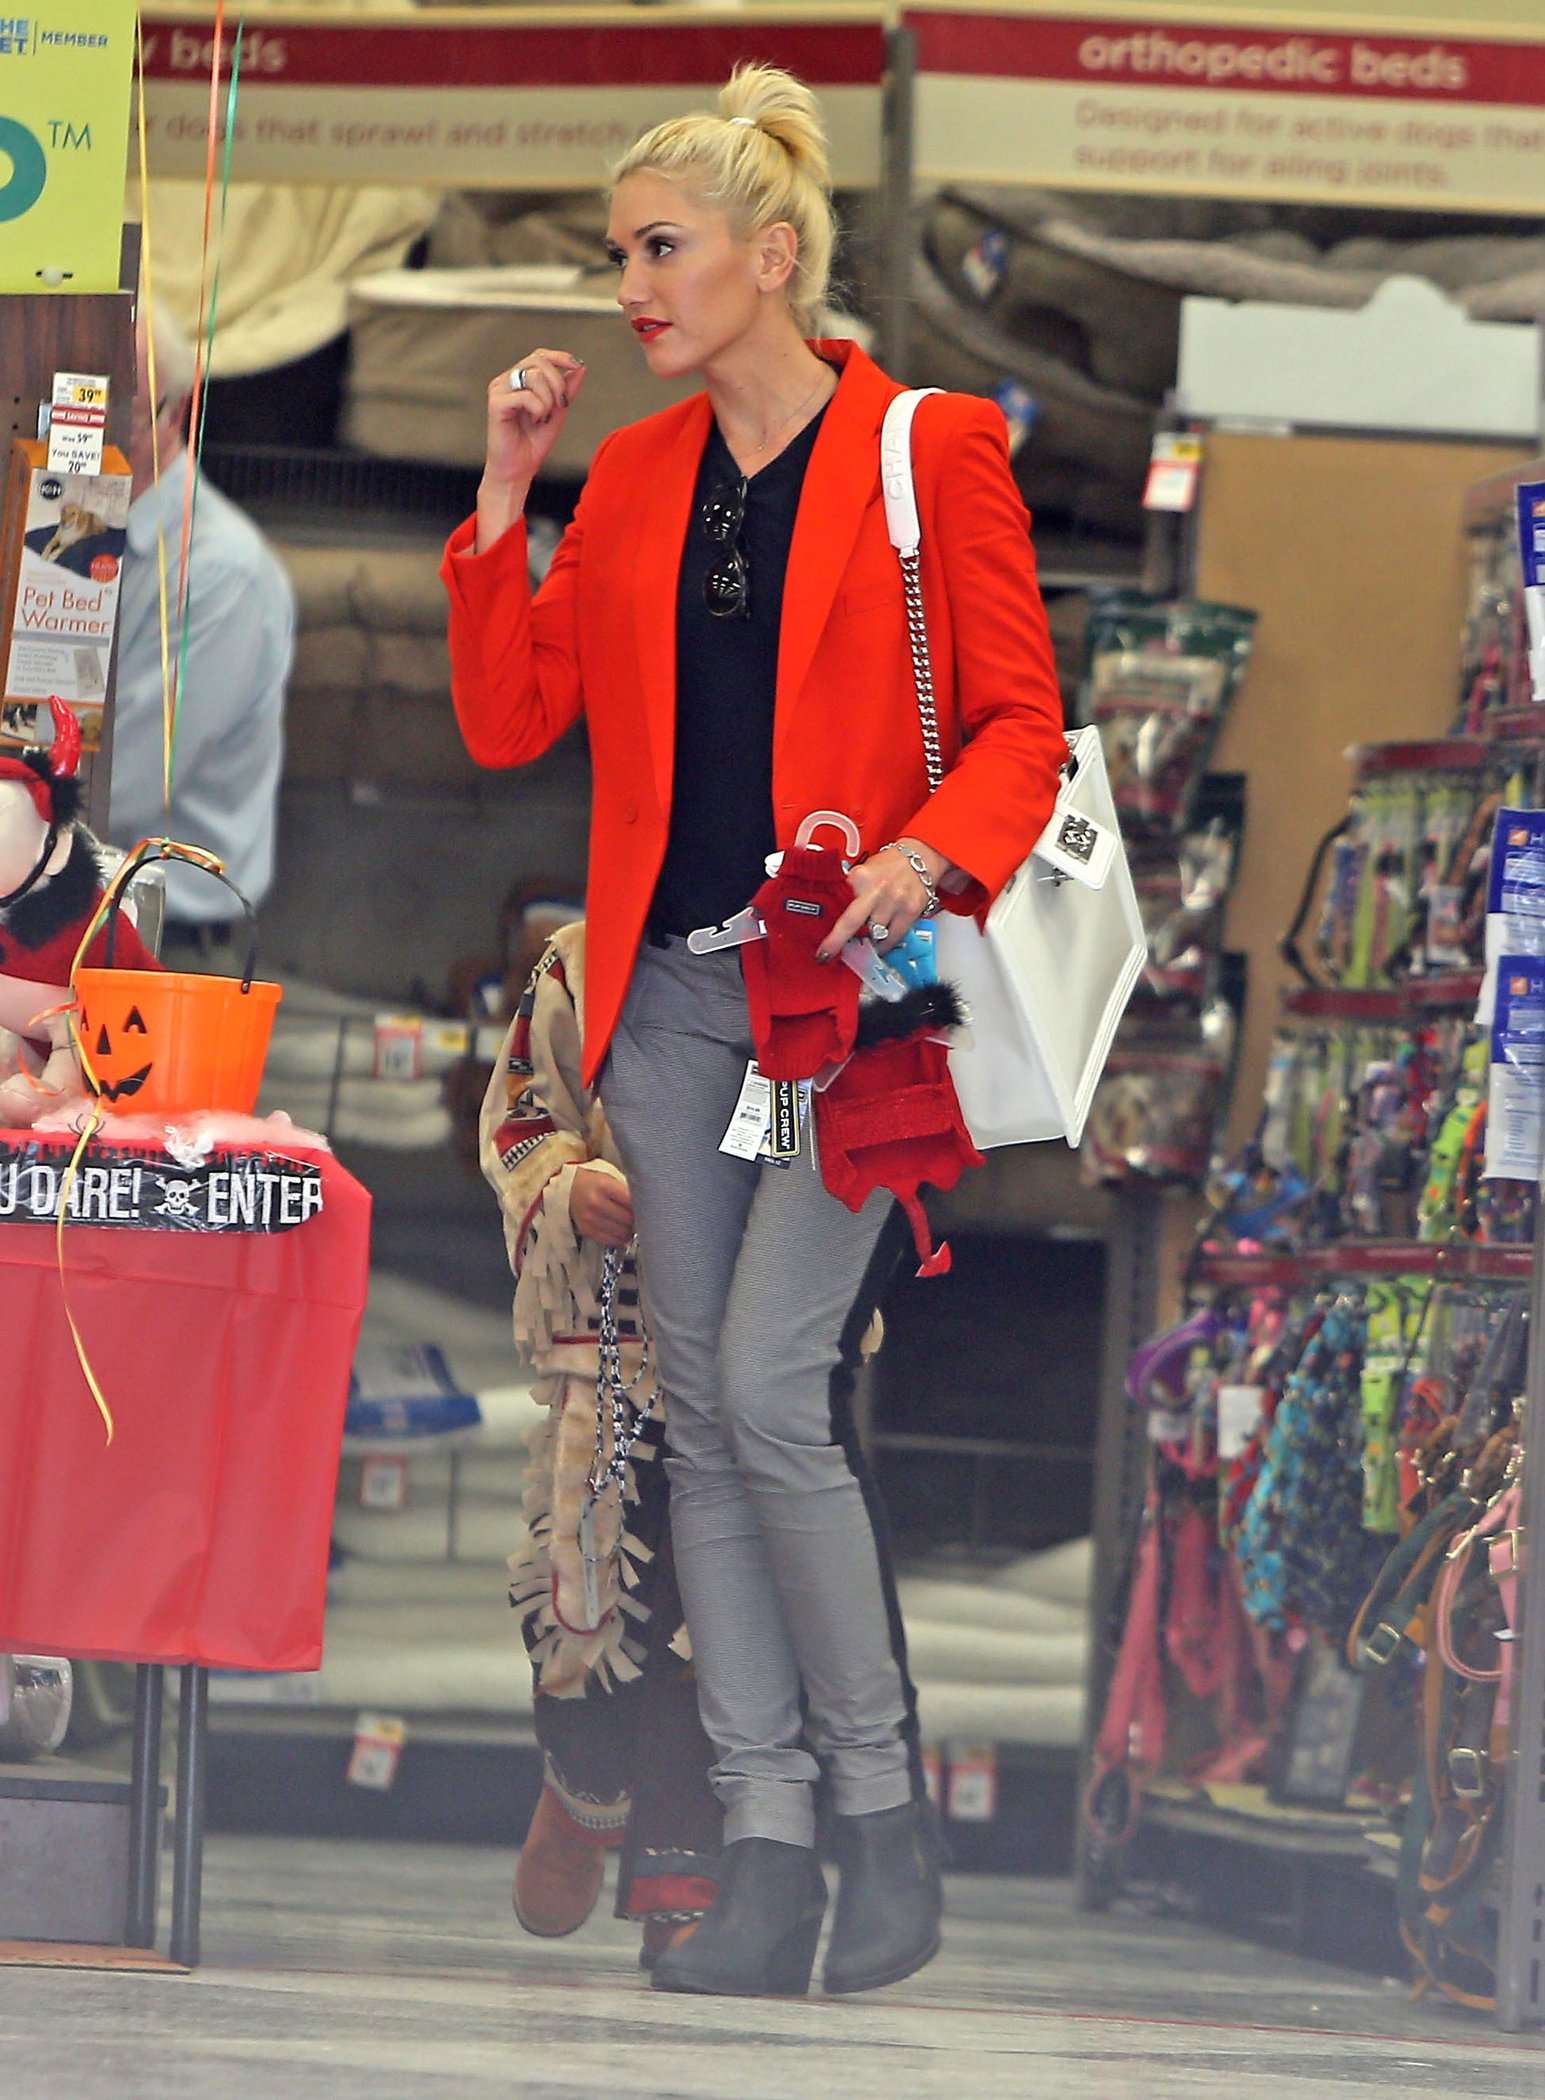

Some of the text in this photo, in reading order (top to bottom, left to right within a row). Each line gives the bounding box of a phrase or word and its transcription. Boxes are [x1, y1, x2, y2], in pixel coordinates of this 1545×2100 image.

[41, 31, 108, 47] MEMBER
[170, 27, 287, 73] beds
[1078, 31, 1468, 91] orthopedic beds
[47, 120, 92, 151] TM
[257, 115, 320, 144] that
[331, 118, 437, 149] sprawl
[447, 118, 507, 145] and
[516, 118, 631, 146] stretch
[1075, 98, 1228, 136] Designed
[1236, 107, 1282, 137] for
[1291, 115, 1387, 142] active
[1396, 118, 1476, 151] dogs
[1074, 145, 1200, 175] support
[1208, 149, 1255, 177] for
[23, 586, 103, 613] Pet Bed
[21, 608, 110, 633] Warmer
[780, 1108, 791, 1150] CREW
[30, 1165, 143, 1218] DARE!
[208, 1172, 323, 1224] ENTER
